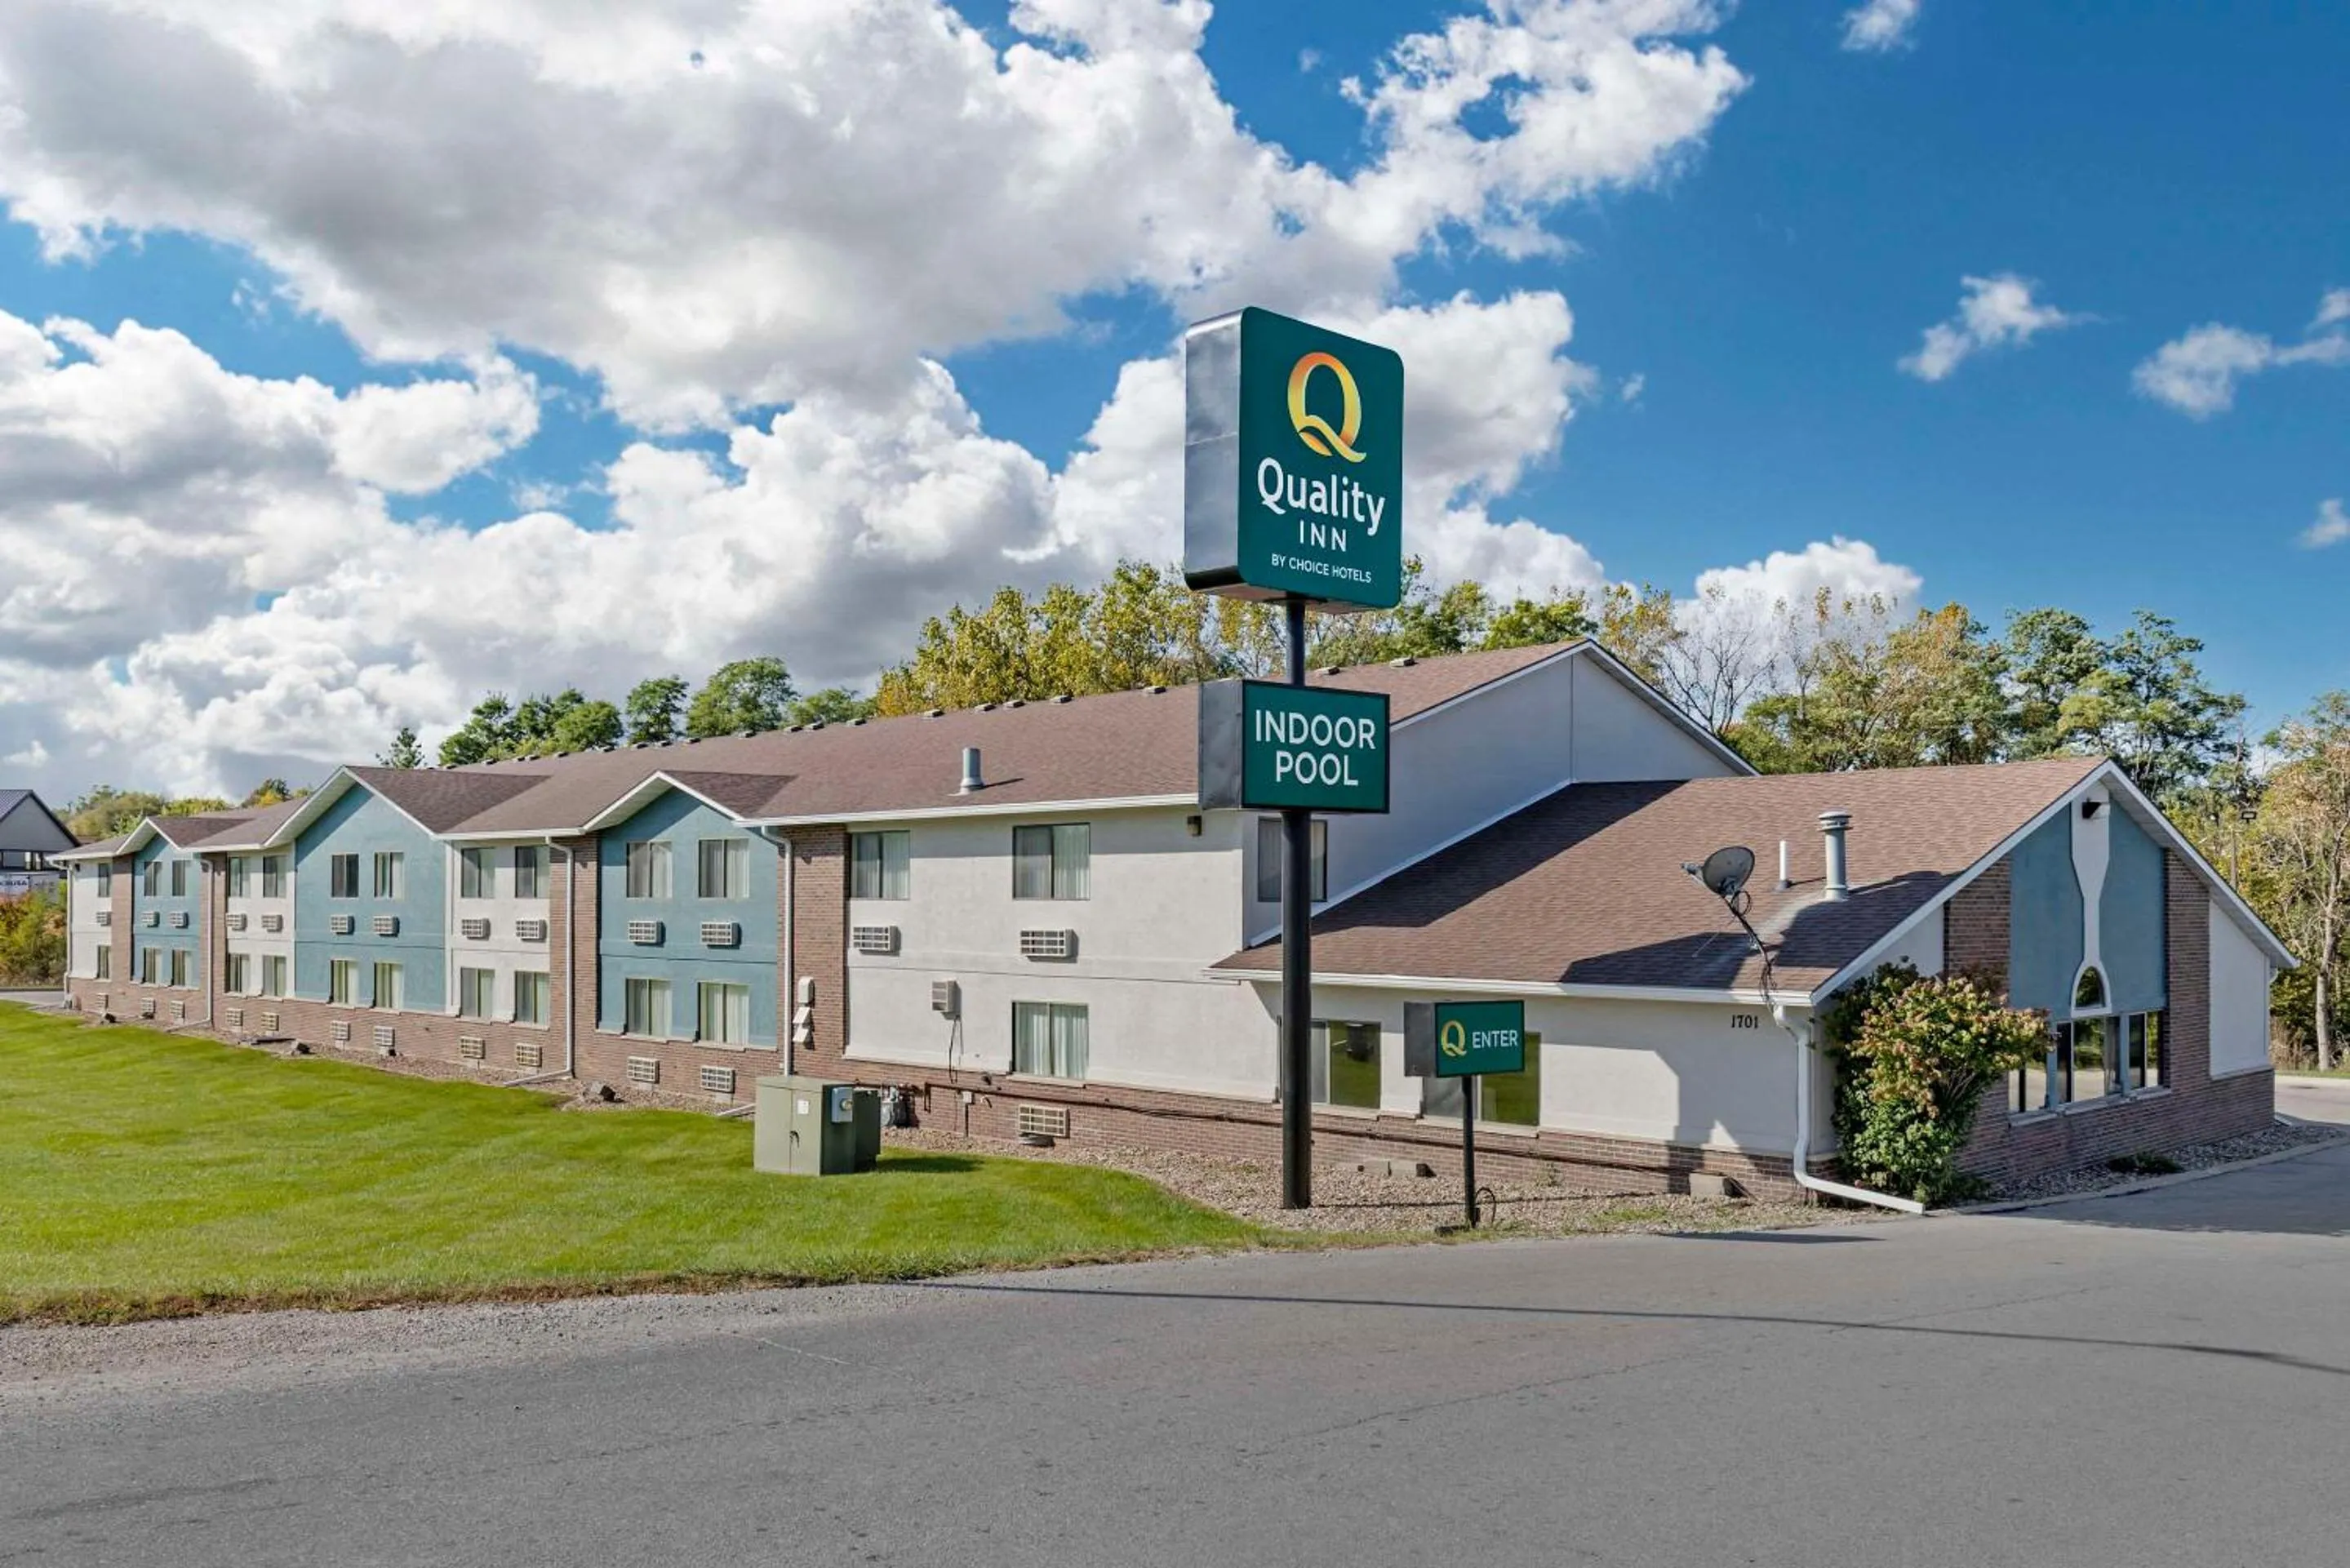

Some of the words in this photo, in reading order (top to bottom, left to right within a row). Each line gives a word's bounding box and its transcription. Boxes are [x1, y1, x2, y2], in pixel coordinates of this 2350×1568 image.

[1287, 352, 1366, 463] Q
[1257, 457, 1386, 536] Quality
[1299, 520, 1347, 552] INN
[1271, 553, 1286, 568] BY
[1289, 557, 1330, 576] CHOICE
[1332, 565, 1372, 584] HOTELS
[1255, 709, 1376, 749] INDOOR
[1276, 750, 1359, 786] POOL
[1441, 1020, 1468, 1057] Q
[1472, 1029, 1518, 1049] ENTER
[1731, 1015, 1758, 1029] 1701
